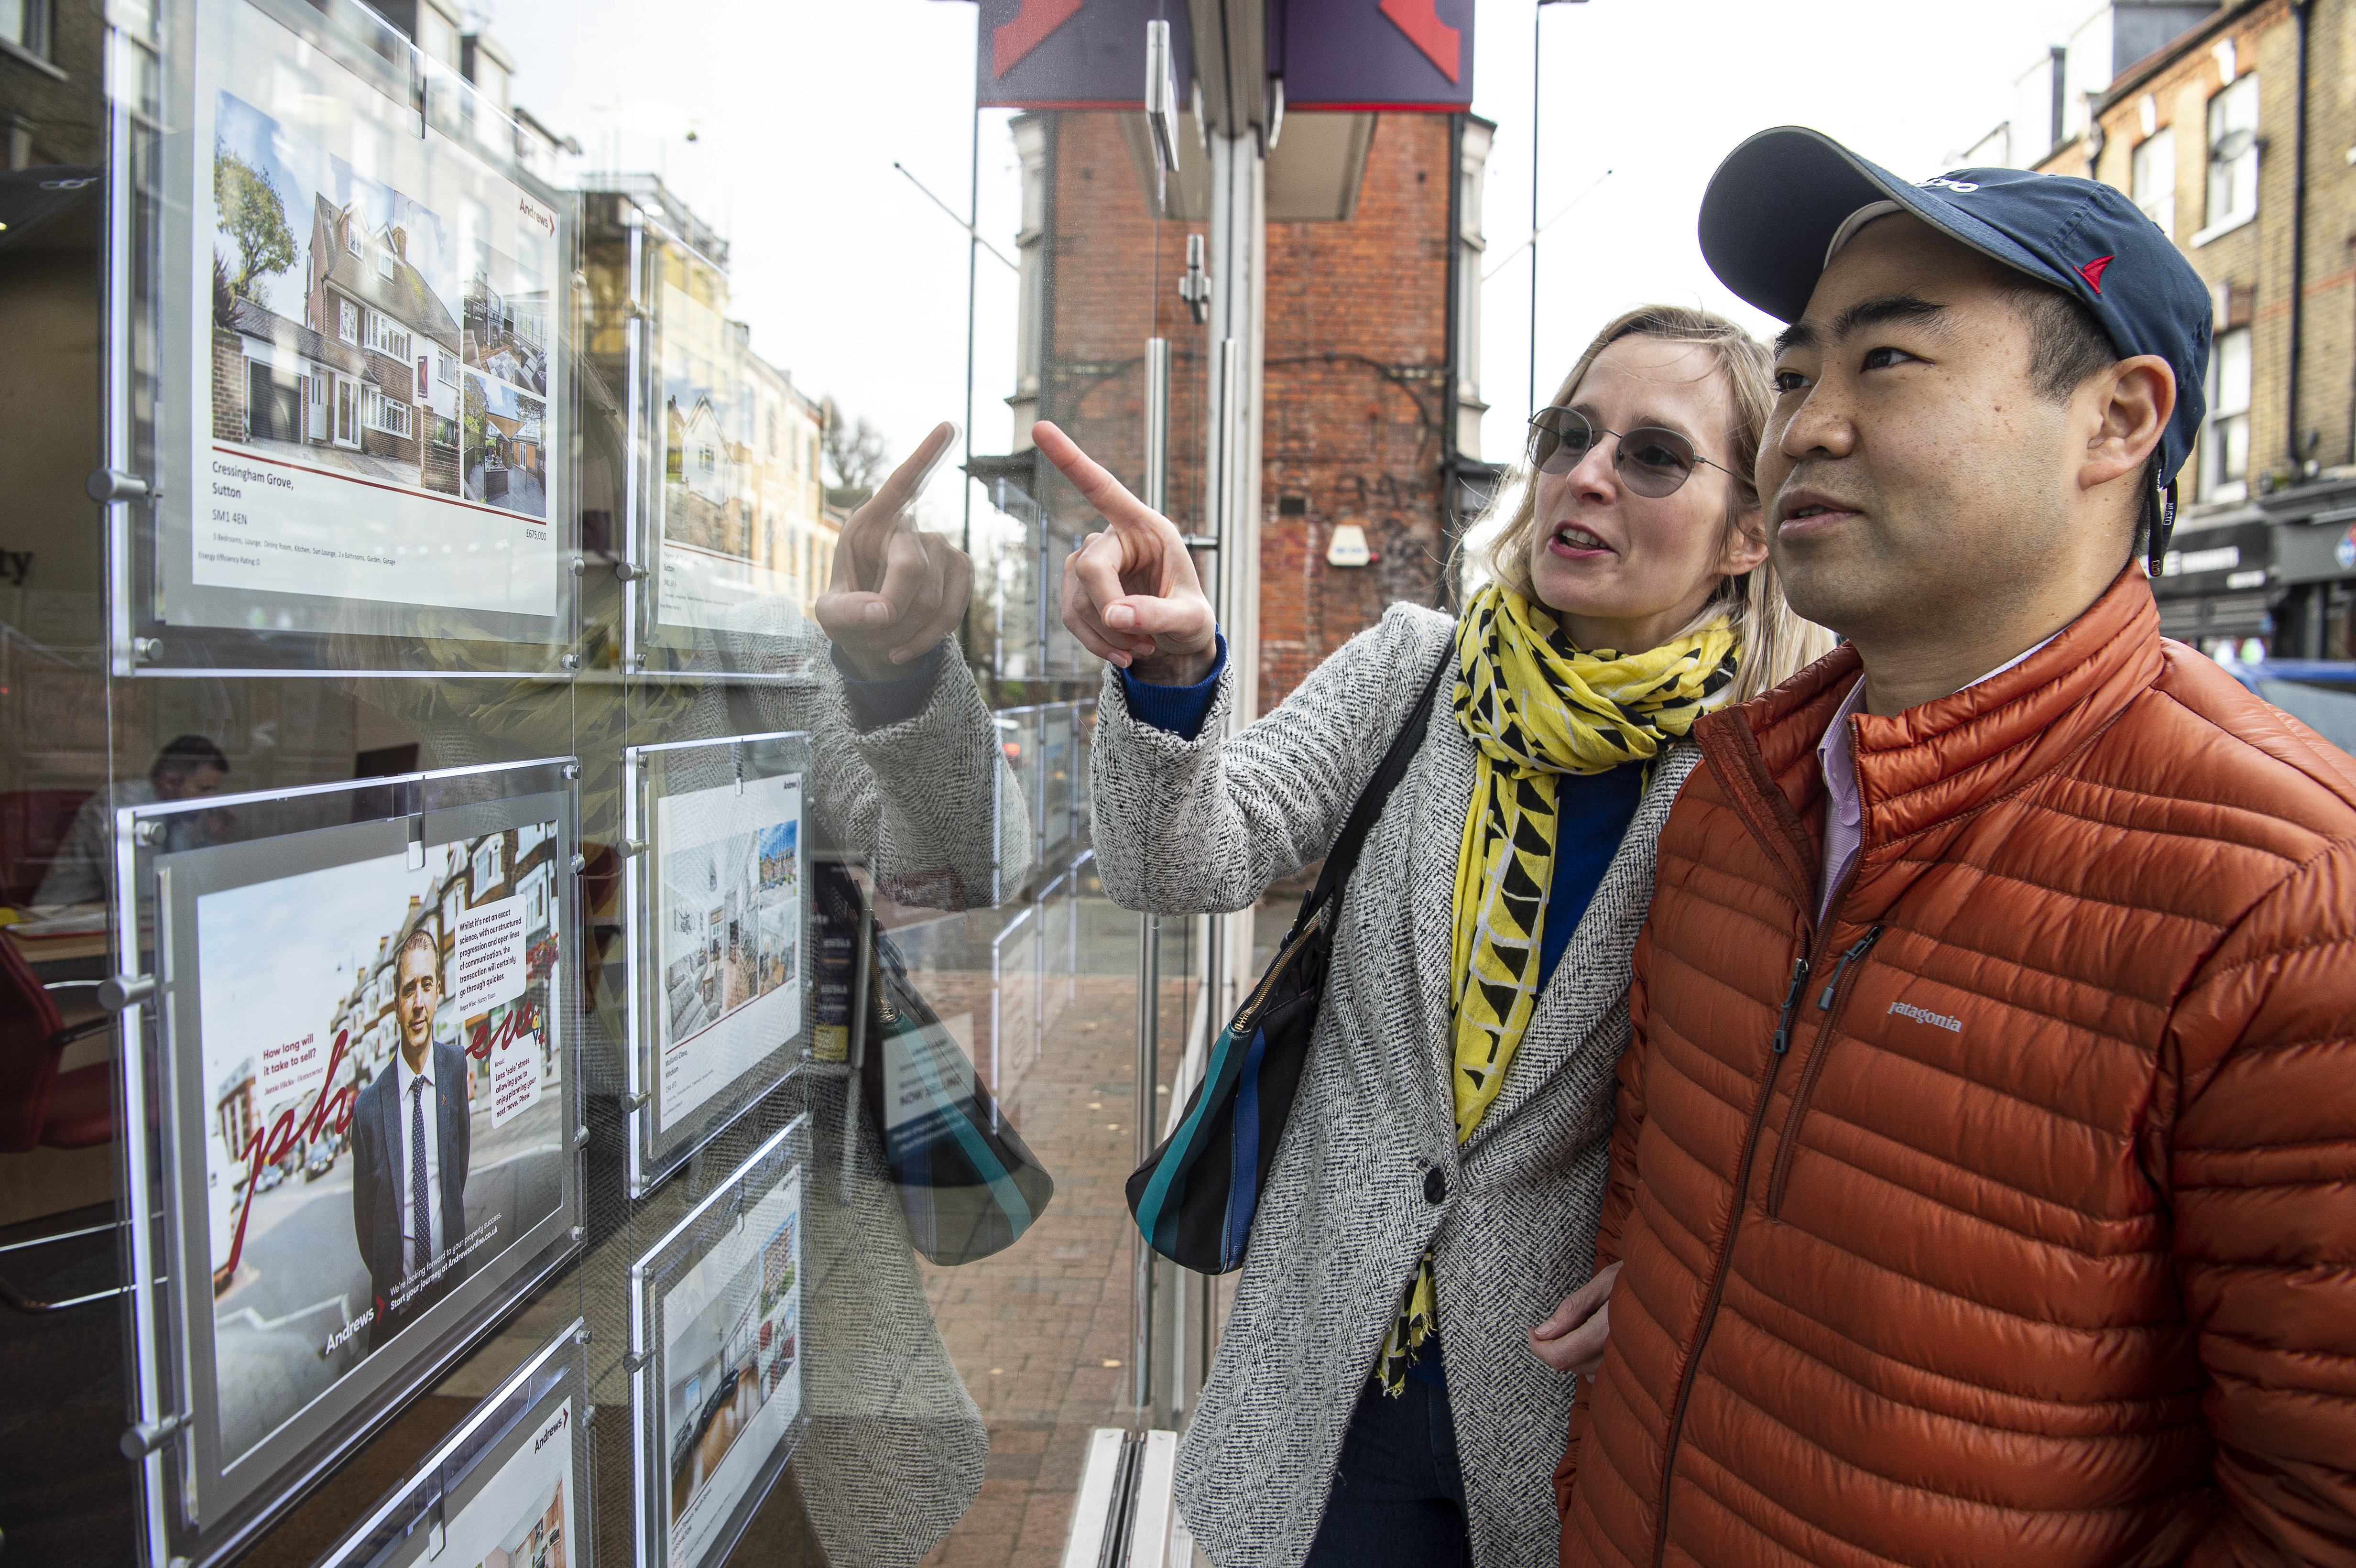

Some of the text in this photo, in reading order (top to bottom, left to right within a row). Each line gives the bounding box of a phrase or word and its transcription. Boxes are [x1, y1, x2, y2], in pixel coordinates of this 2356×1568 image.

[520, 197, 548, 229] Andrews
[212, 460, 294, 490] Cressingham Grove,
[212, 482, 241, 499] Sutton
[212, 509, 247, 525] SM1 4EN
[2163, 502, 2174, 525] MUSTO
[526, 529, 547, 541] £675,000
[198, 551, 215, 562] Energy
[216, 553, 239, 564] Efficiency
[217, 534, 243, 544] Bedrooms,
[244, 538, 262, 547] Lounge,
[278, 543, 293, 552] Room,
[294, 544, 311, 554] Kitchen,
[321, 549, 337, 558] Lounge,
[345, 552, 366, 561] Bathrooms,
[367, 555, 382, 564] Garden,
[383, 558, 396, 566] Garage
[459, 921, 474, 932] Whilst
[498, 909, 511, 919] exact
[459, 933, 479, 945] science,
[479, 927, 489, 938] with
[498, 916, 522, 931] structured
[459, 931, 520, 960] progression and open lines
[459, 961, 465, 971] of
[465, 950, 502, 969] communication,
[459, 955, 516, 983] transaction will certainly
[460, 973, 505, 999] go through quicker.
[459, 1004, 469, 1012] Roger
[1887, 1002, 1963, 1033] patagonia
[263, 1033, 314, 1060] How long will
[264, 1047, 316, 1076] it take to sell?
[495, 1072, 505, 1082] Less
[518, 1058, 530, 1069] stress
[264, 1084, 279, 1096] Jamie
[280, 1078, 294, 1089] Hicks
[297, 1067, 324, 1083] Homeowner
[496, 1078, 514, 1093] allowing
[514, 1074, 523, 1085] you
[496, 1077, 536, 1106] enjoy planning your
[496, 1092, 531, 1118] next move. Phew.
[390, 1212, 502, 1296] We're looking forward to your property success.
[390, 1225, 499, 1311] Start your journey at Andrewsonline.co.uk
[325, 1307, 374, 1356] Andrews
[534, 1418, 562, 1454] Andrews
